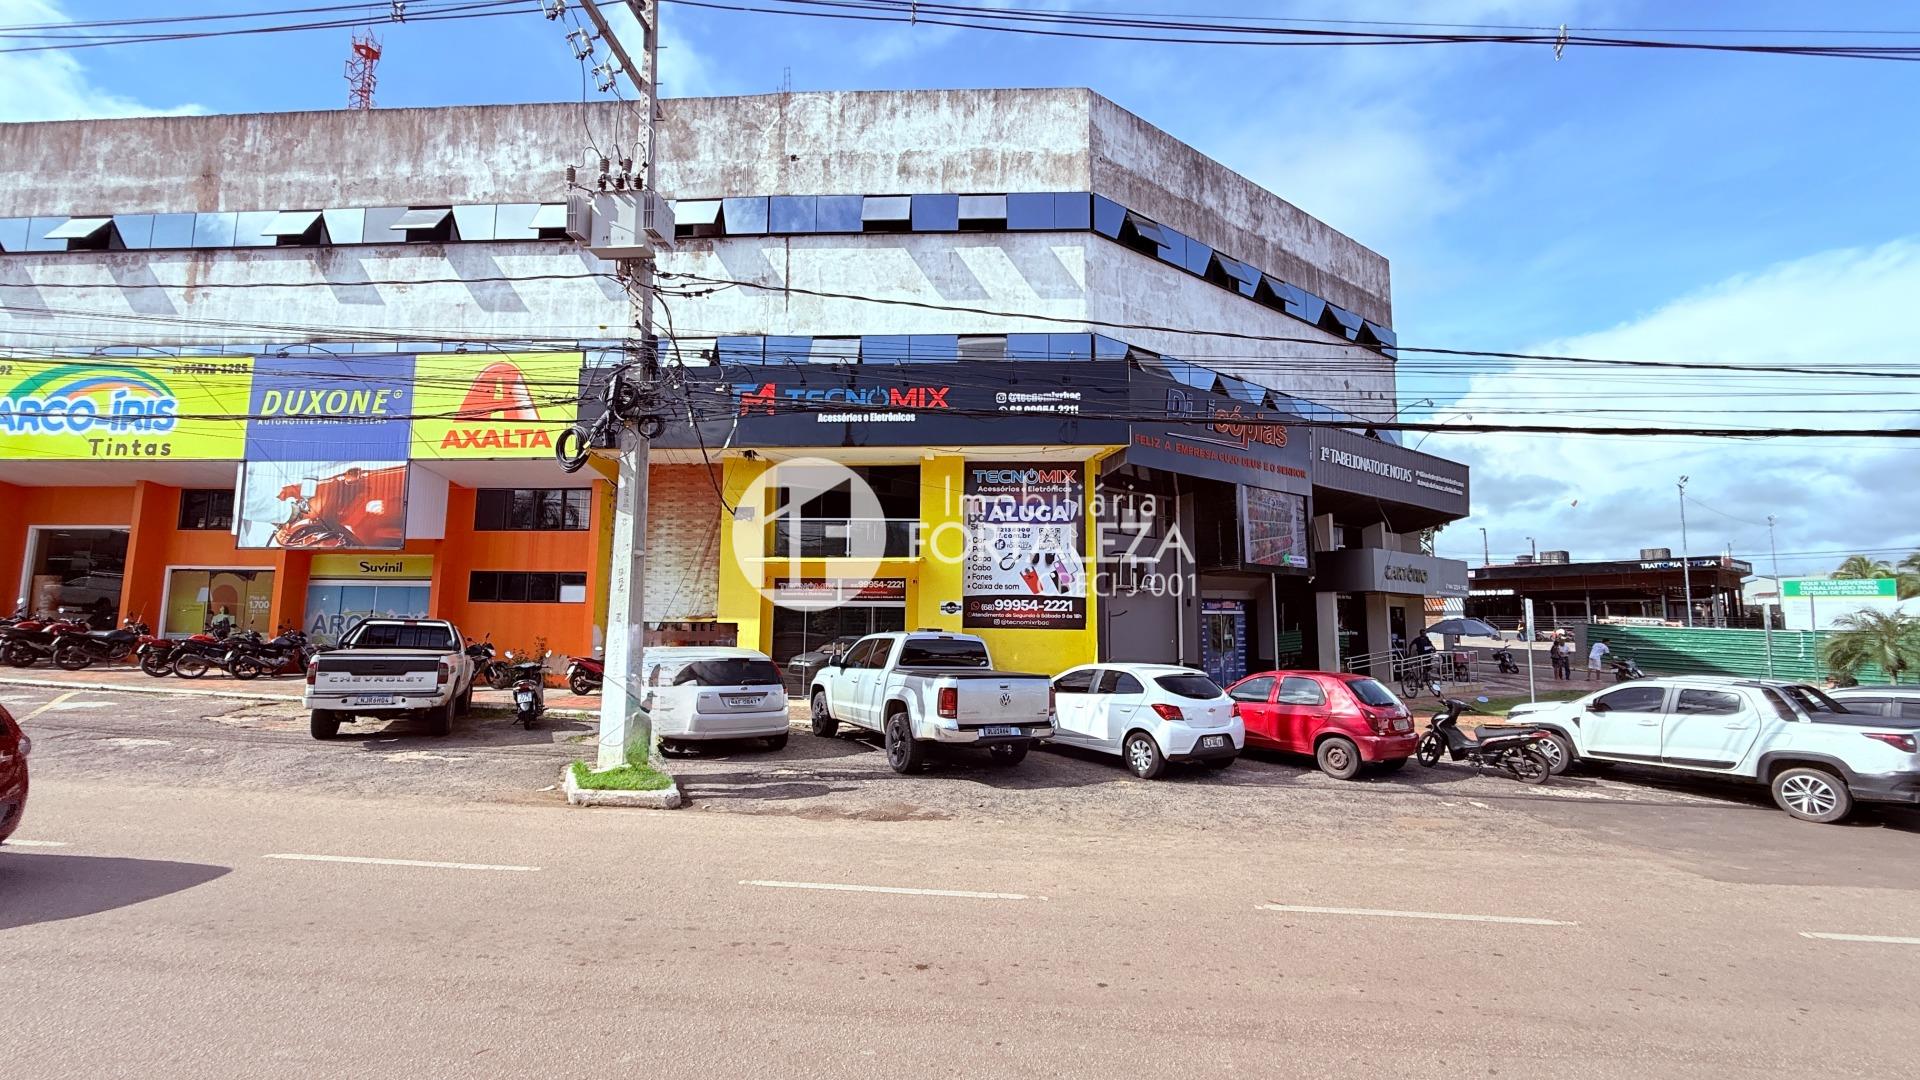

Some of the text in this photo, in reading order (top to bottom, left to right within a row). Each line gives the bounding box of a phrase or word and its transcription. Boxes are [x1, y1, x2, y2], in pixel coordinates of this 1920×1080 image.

[261, 390, 391, 416] DUXONE
[784, 386, 949, 408] TECNOMIX
[818, 412, 861, 423] Acessórios
[870, 412, 916, 422] Eletrônicos
[88, 438, 172, 456] Tintas
[440, 429, 552, 449] AXALTA
[1134, 433, 1161, 449] FELIZ
[1164, 440, 1172, 450] A
[1175, 443, 1217, 461] EMPRESA
[1330, 449, 1380, 475] TABELIONATO
[1381, 463, 1390, 477] DE
[1390, 464, 1413, 483] NOTAS
[973, 468, 1077, 484] TECNOMIX
[977, 485, 1020, 493] Acessórios
[359, 561, 403, 573] Suvinil
[994, 599, 1073, 612] 99954-2221
